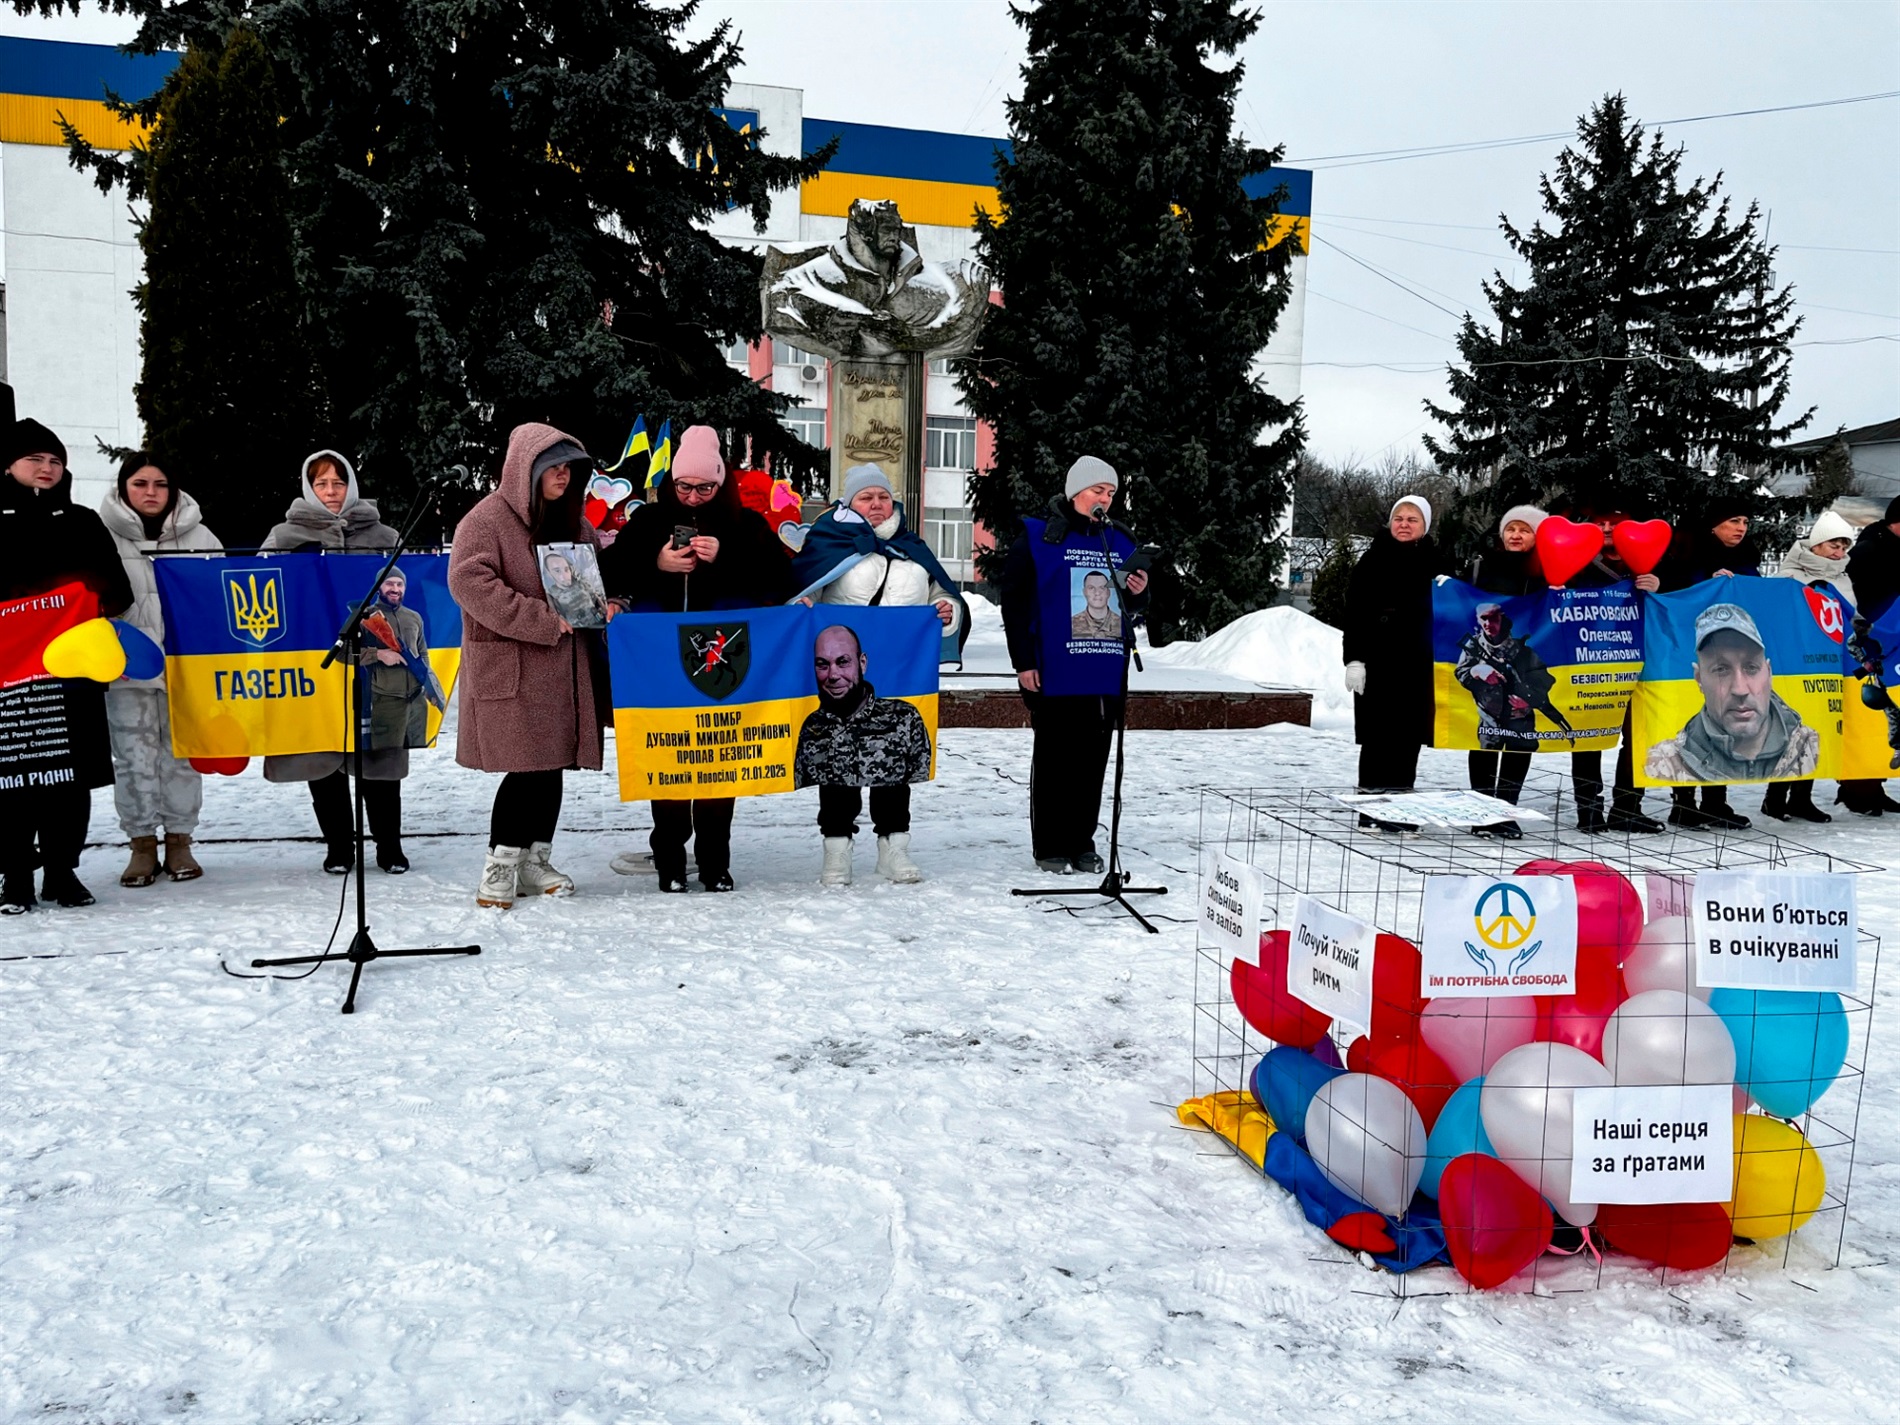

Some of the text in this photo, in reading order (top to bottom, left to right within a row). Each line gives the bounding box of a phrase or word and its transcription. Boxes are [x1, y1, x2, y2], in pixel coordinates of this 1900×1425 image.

[1579, 627, 1633, 644] Олександр
[1575, 647, 1641, 662] Михайлович
[215, 668, 315, 700] ГАЗЕЛЬ
[1571, 673, 1612, 684] БЕЗВІСТІ
[24, 694, 64, 703] Михайлович
[1, 705, 65, 717] Максим Вікторович
[695, 711, 741, 728] 110 ОМБР
[36, 727, 68, 736] Юрійович
[646, 723, 791, 748] ДУБОВИЙ МИКОЛА ЮРІЙОВИЧ
[30, 738, 69, 748] Степанович
[19, 749, 70, 760] Олександрович
[677, 744, 763, 764] ПРОПАВ БЕЗВІСТИ
[28, 768, 74, 786] РІДНІ!
[647, 764, 786, 786] У Великій Новосілці 21.01.2025
[1207, 885, 1243, 917] сильніша
[1706, 900, 1765, 923] Вони
[1206, 906, 1243, 938] за залізо
[1298, 923, 1360, 971] Почуй їхній
[1709, 935, 1840, 963] в очікуванні
[1312, 967, 1341, 993] ритм
[1429, 974, 1567, 986] ЇМ ПОТРІБНА СВОБОДА
[1593, 1118, 1708, 1143] Наші серця
[1592, 1155, 1705, 1178] за ґратами
